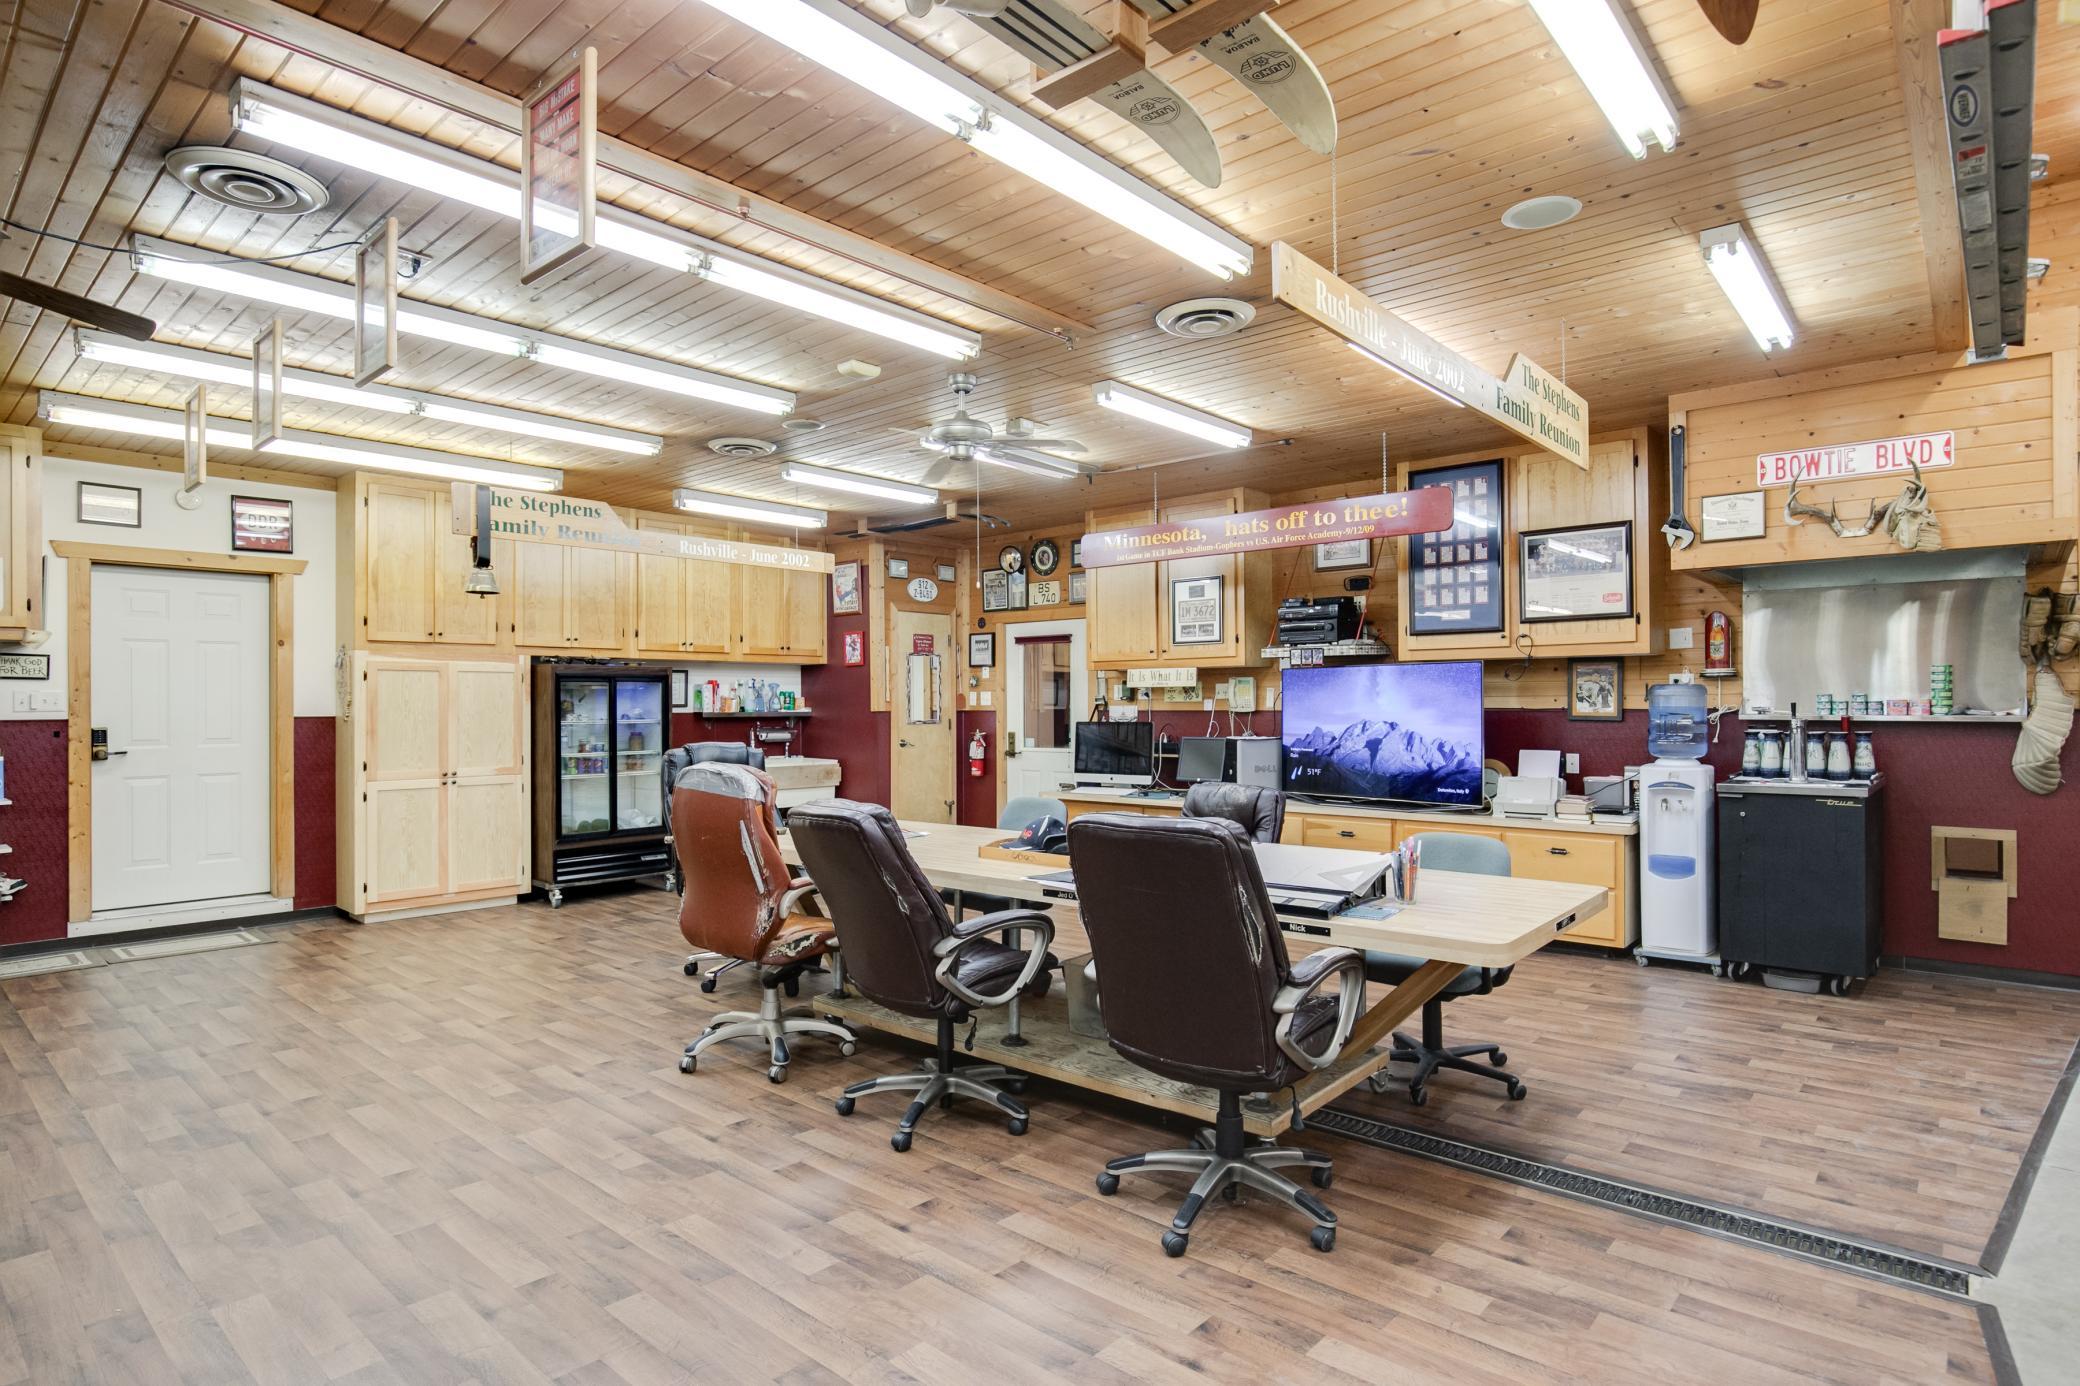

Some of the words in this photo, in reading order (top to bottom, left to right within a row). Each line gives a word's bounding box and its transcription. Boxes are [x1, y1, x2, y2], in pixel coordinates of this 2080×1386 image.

[1225, 36, 1261, 54] BALBOA
[1252, 60, 1292, 80] LUND
[1113, 83, 1145, 100] BALBOA
[1141, 105, 1176, 122] LUND
[1316, 278, 1388, 349] Rushville
[1400, 333, 1432, 375] June
[1435, 358, 1465, 393] 2002
[1521, 363, 1540, 396] The
[1542, 378, 1580, 421] Stephens
[1496, 386, 1537, 436] Family
[1539, 413, 1581, 456] Reunion
[1774, 447, 1857, 481] BOWTIE
[1875, 439, 1934, 469] BLVD
[490, 491, 513, 509] he
[520, 495, 603, 519] Stephens
[1103, 528, 1207, 550] Minnesota,
[1224, 517, 1269, 537] hats
[1275, 510, 1309, 531] off
[1313, 508, 1337, 526] to
[1343, 497, 1408, 523] thee!
[1255, 535, 1270, 546] U.S.
[1271, 534, 1284, 545] Air
[1284, 531, 1307, 543] Force
[679, 540, 738, 560] Rushville
[750, 547, 779, 564] June
[781, 552, 810, 567] 2002
[1038, 582, 1050, 594] BS
[1041, 592, 1056, 604] 740
[1194, 605, 1216, 617] 3672
[1289, 923, 1306, 932] Nick
